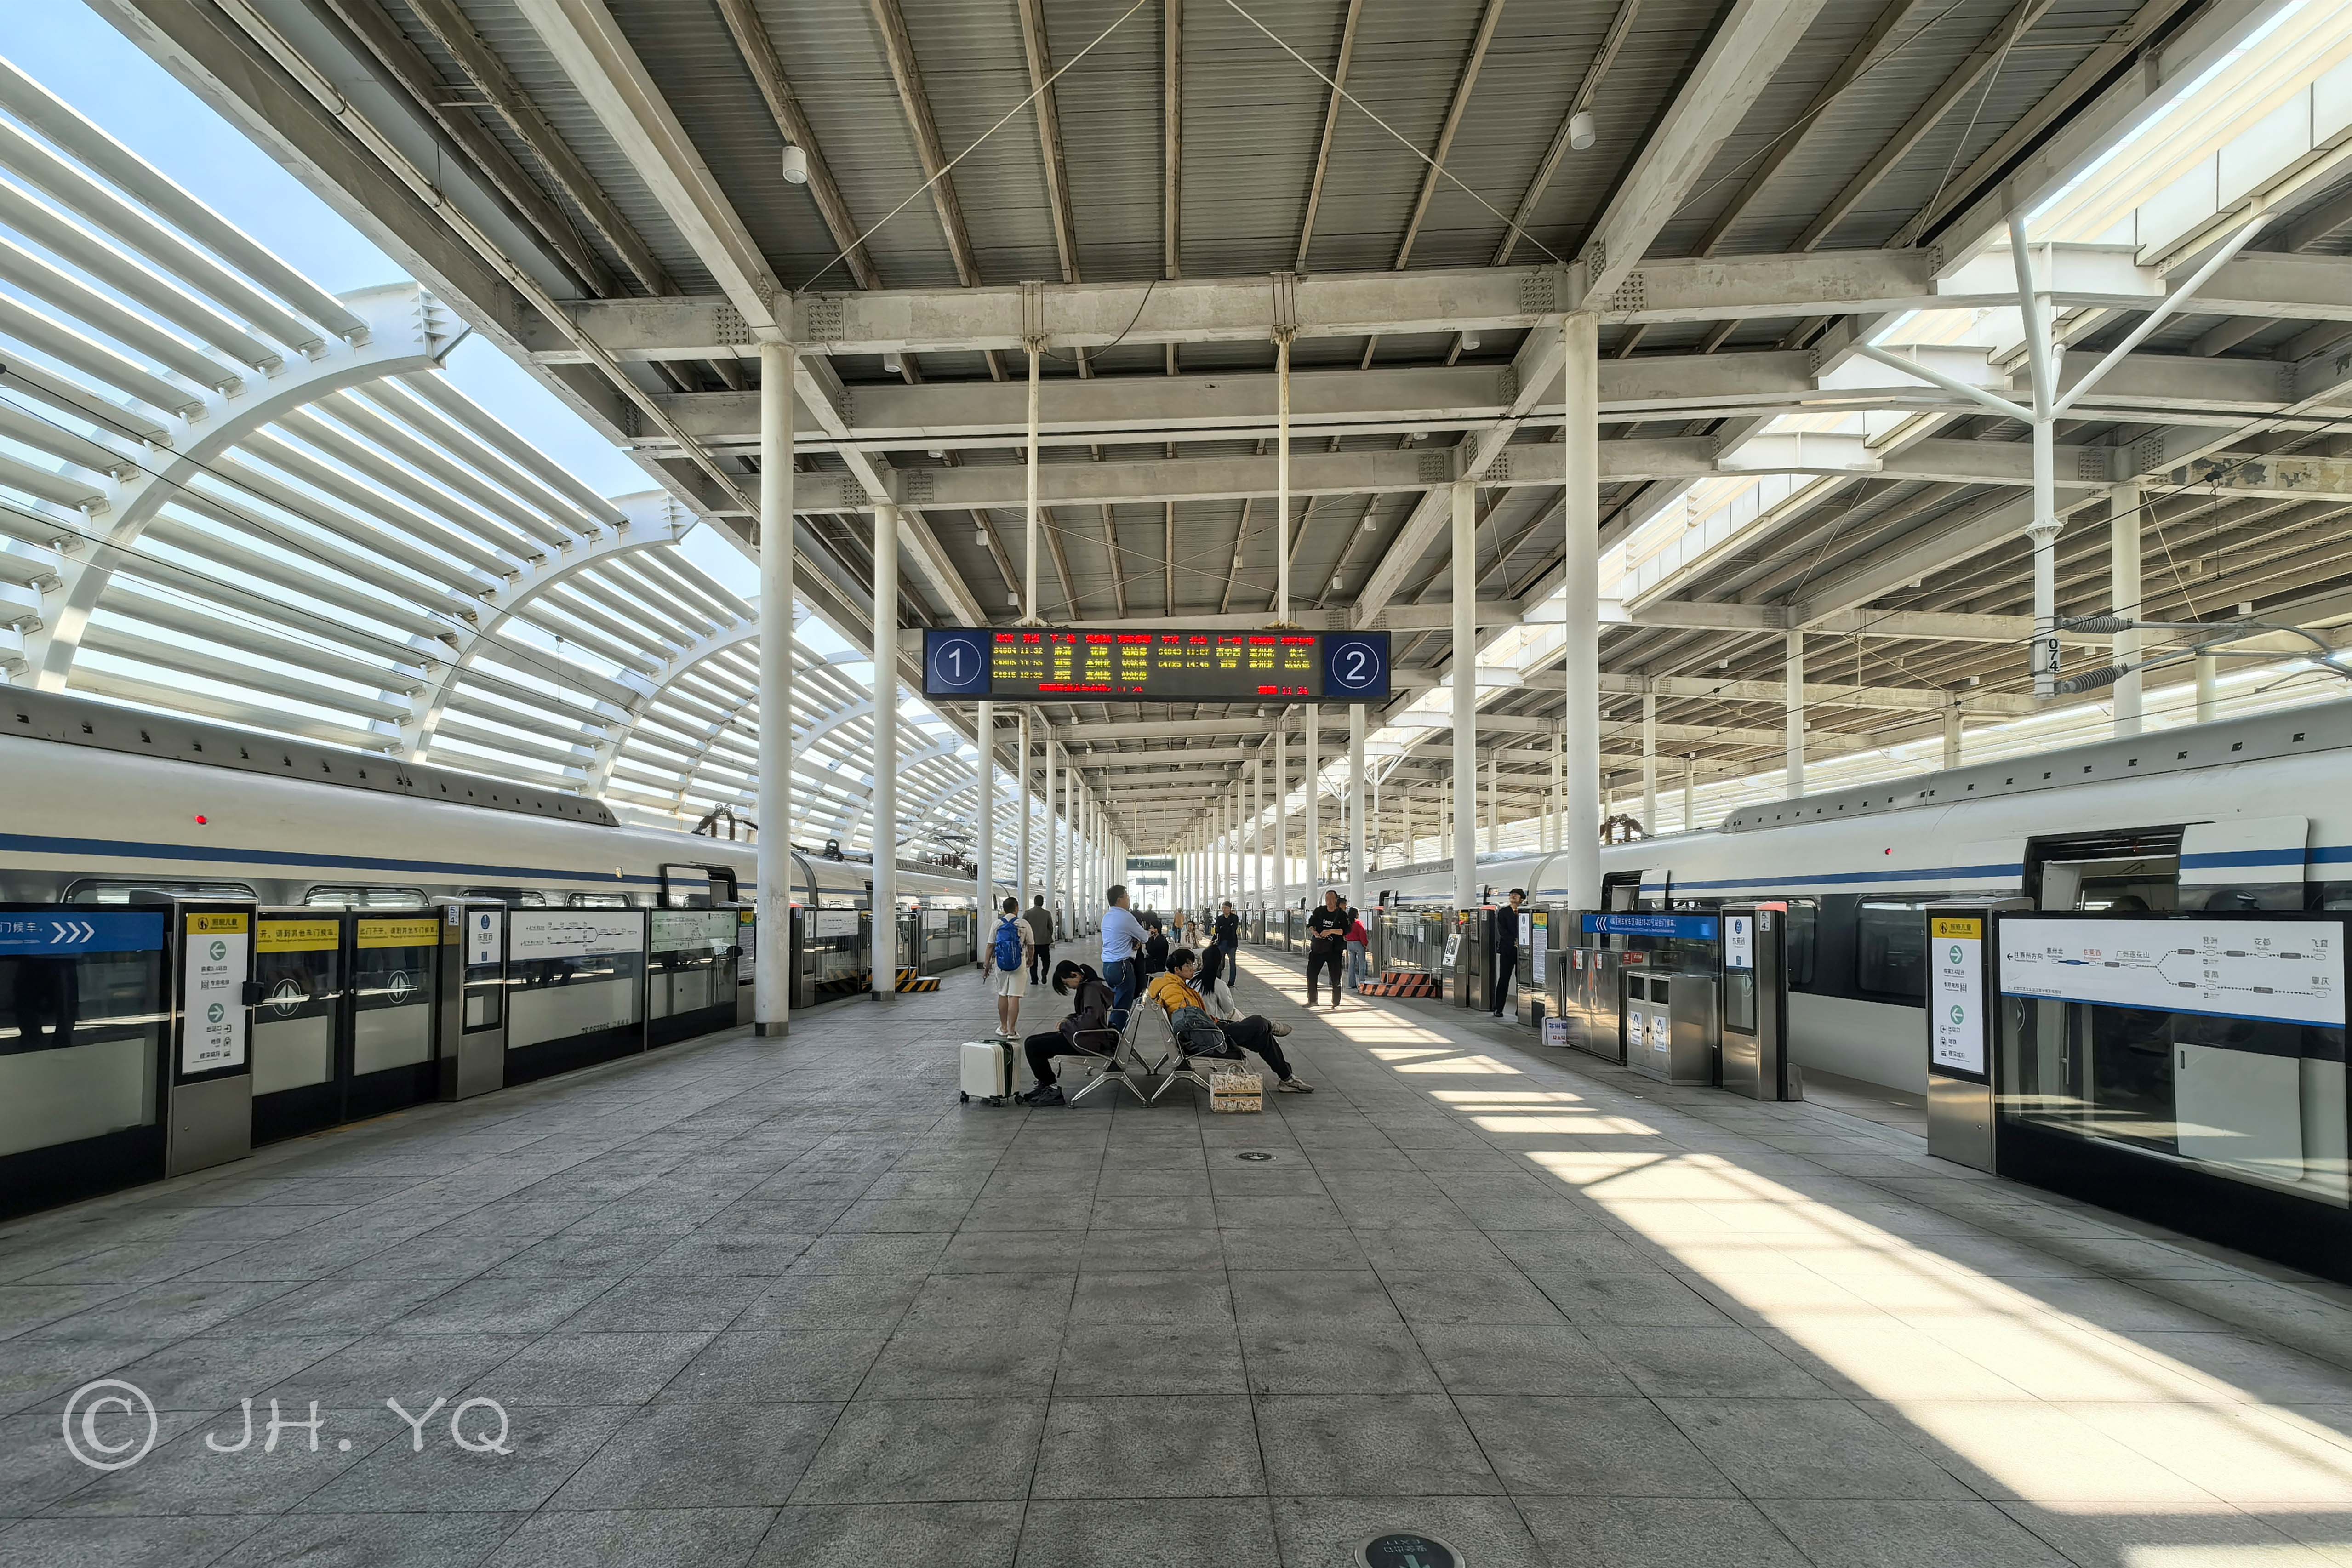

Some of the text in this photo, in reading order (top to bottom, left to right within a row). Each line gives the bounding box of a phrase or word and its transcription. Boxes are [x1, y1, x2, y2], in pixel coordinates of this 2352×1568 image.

[948, 649, 961, 677] 1
[1346, 651, 1366, 680] 2
[2048, 638, 2059, 672] 074
